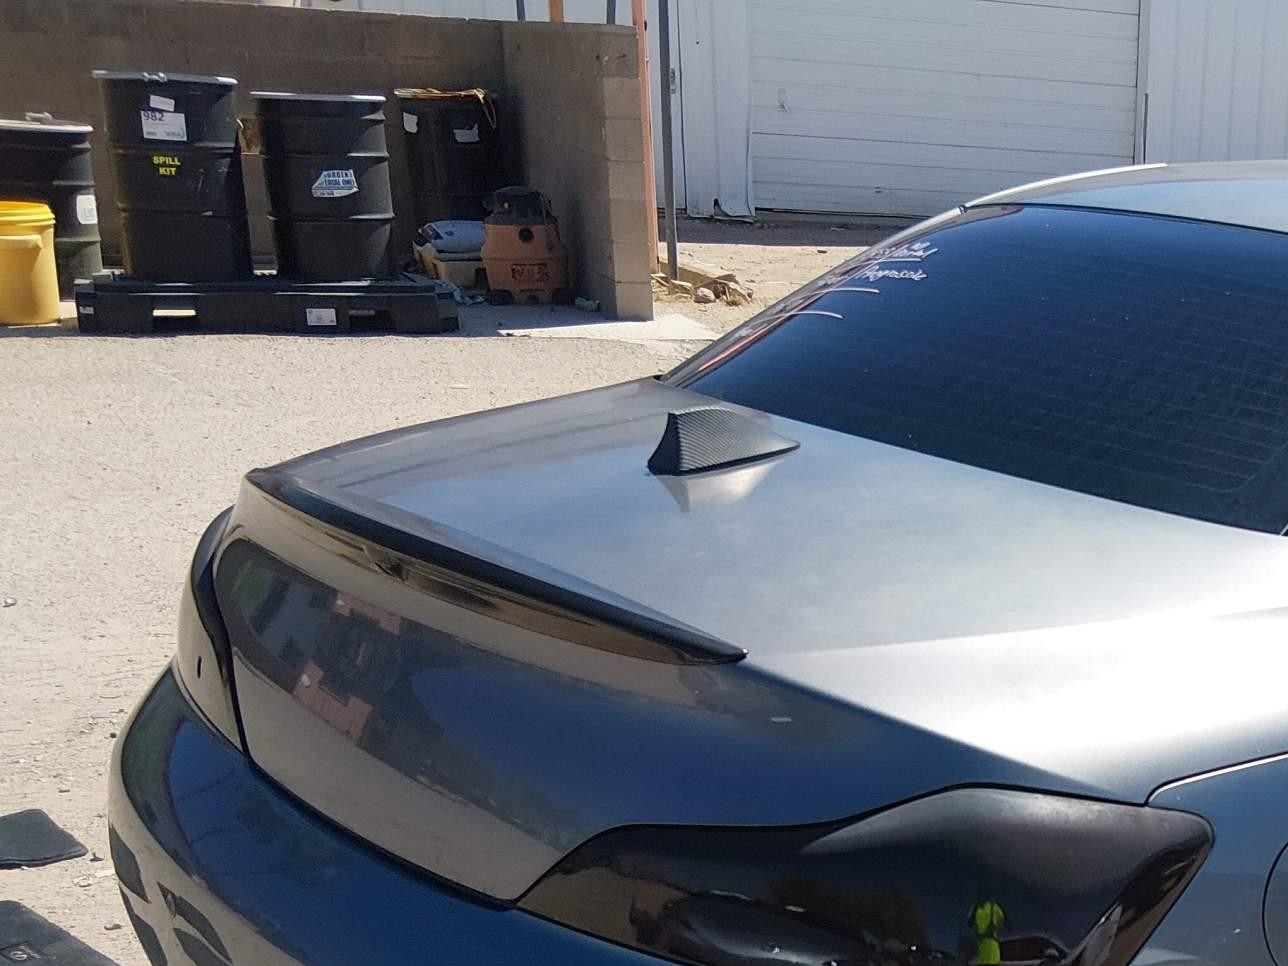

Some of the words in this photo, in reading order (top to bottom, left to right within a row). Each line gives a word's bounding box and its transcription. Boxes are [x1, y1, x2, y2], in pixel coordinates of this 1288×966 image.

[143, 112, 165, 122] 982
[152, 155, 182, 166] SPILL
[159, 167, 177, 176] KIT
